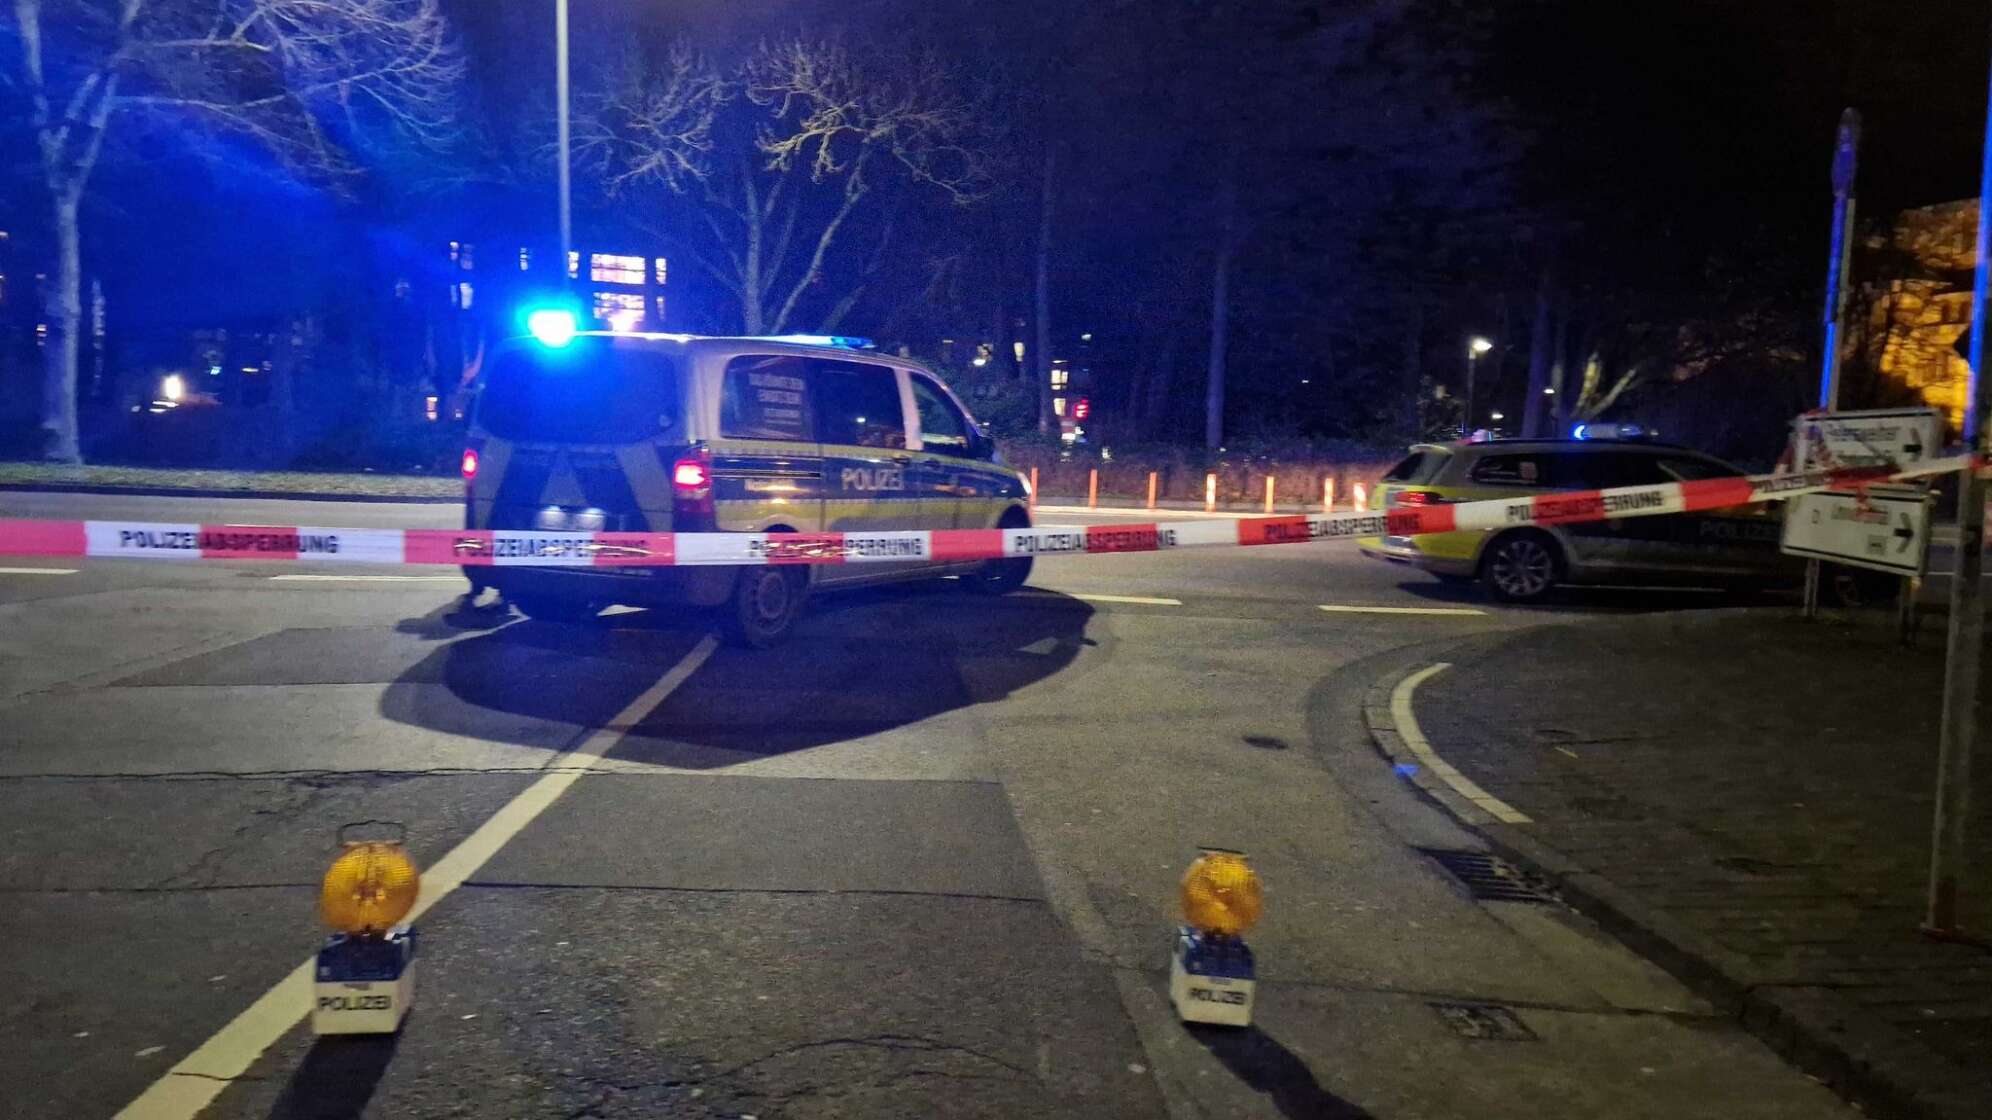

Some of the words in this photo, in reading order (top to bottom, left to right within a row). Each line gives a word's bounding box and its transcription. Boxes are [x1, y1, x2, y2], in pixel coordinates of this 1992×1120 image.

[841, 468, 904, 490] POLIZEI
[119, 530, 339, 553] POLIZEIABSPERRUNG
[1015, 529, 1176, 552] POLIZEIABSPERRUNG
[319, 995, 392, 1011] POLIZEI
[1190, 988, 1248, 1006] POLIZEI
